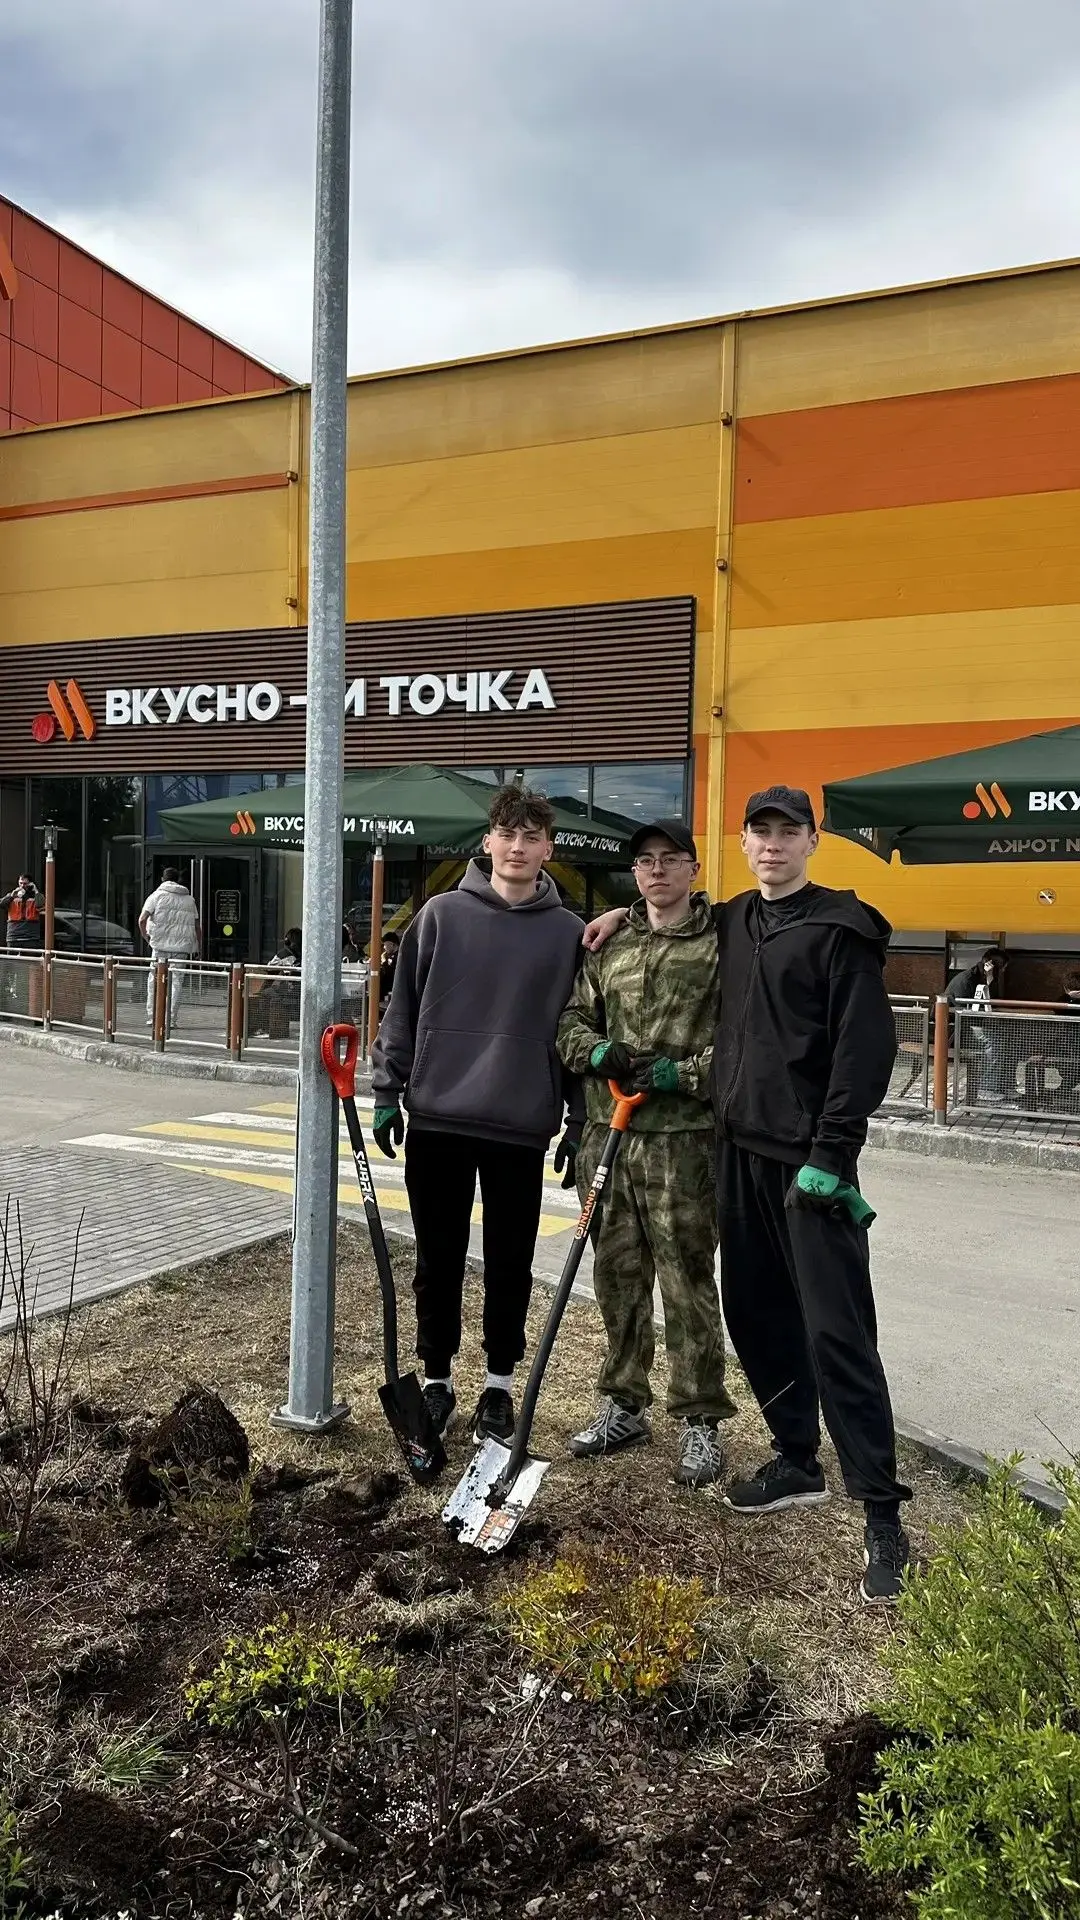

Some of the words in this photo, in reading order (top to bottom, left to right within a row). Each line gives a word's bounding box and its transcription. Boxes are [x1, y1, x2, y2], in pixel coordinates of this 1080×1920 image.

[105, 682, 282, 726] ВКУСНО
[379, 668, 557, 716] ТОЧКА
[264, 816, 305, 831] ВКУС
[343, 817, 356, 832] И
[554, 831, 588, 847] ВКУСНО
[353, 1150, 375, 1204] SHARK
